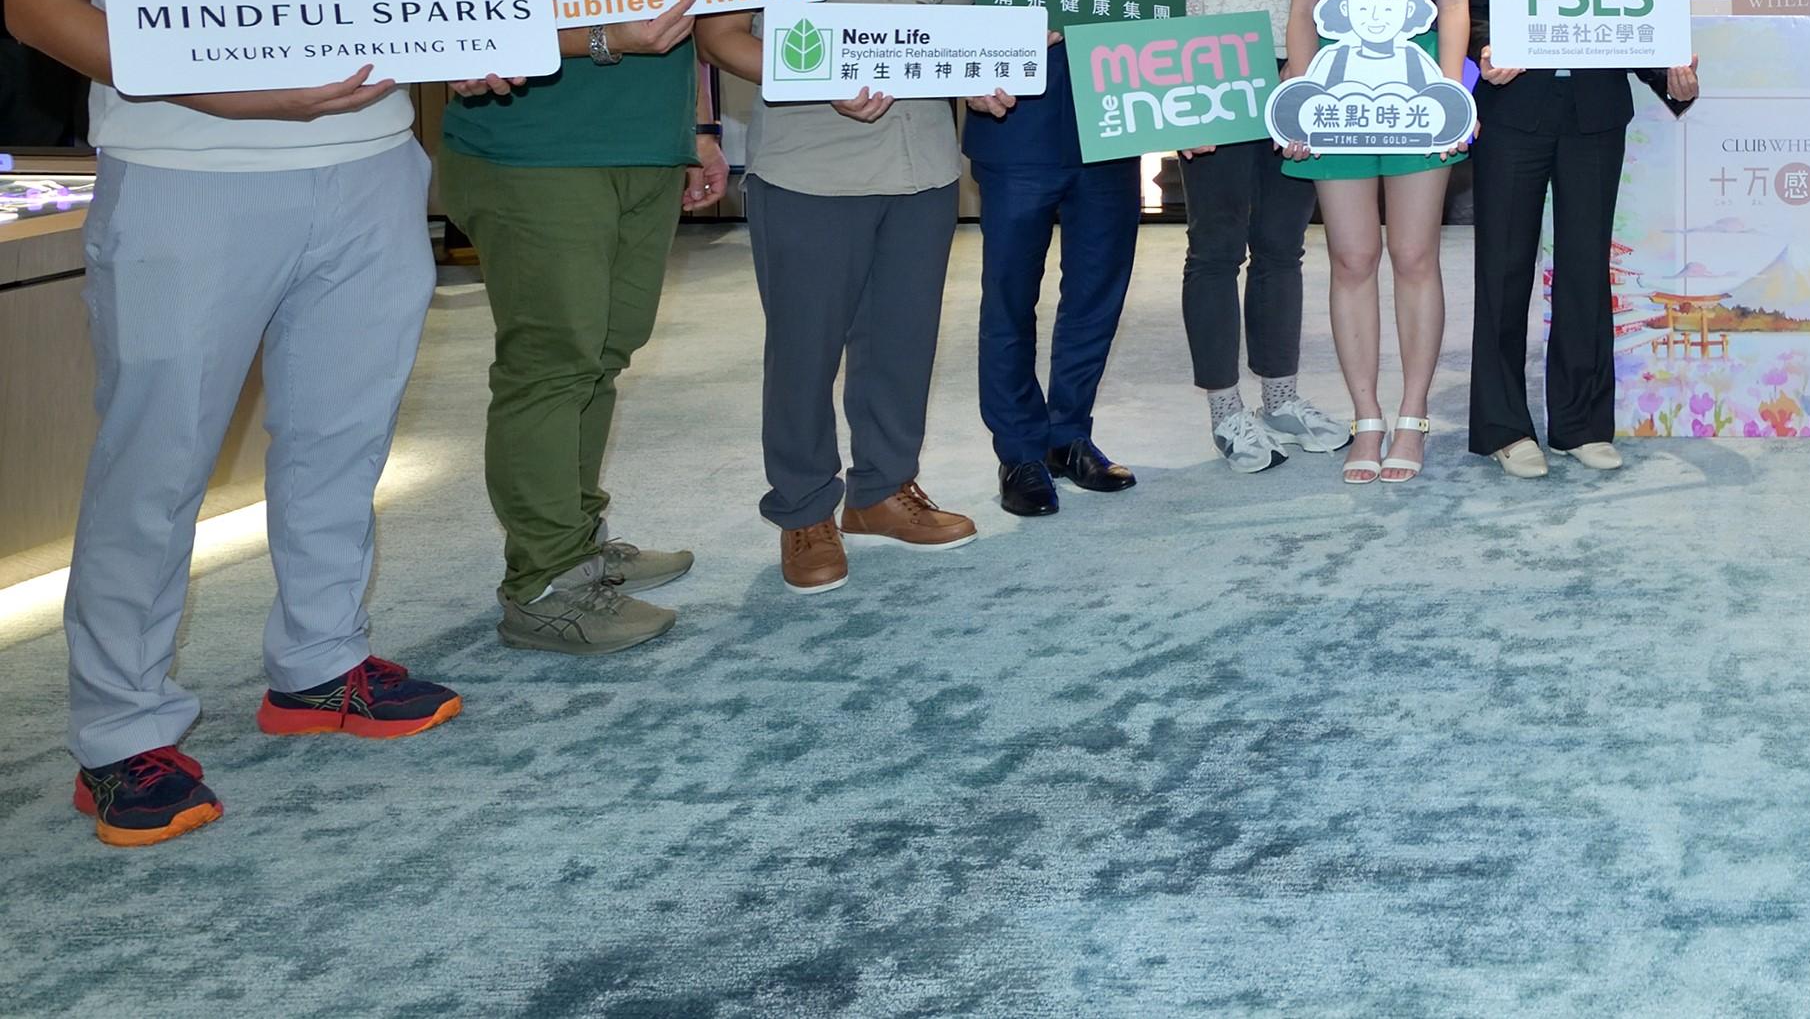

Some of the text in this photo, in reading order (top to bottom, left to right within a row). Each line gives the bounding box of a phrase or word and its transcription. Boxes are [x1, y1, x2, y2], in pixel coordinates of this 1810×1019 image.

[136, 0, 532, 30] MINDFUL SPARKS
[842, 28, 931, 45] New Life
[1528, 23, 1655, 43] 豐盛社企學會
[191, 38, 497, 62] LUXURY SPARKLING TEA
[841, 48, 1037, 61] Psychiatric Rehabilitation Association
[1527, 47, 1656, 57] Fullness Social Enterprises Society
[841, 61, 1038, 81] 新生精神康復會
[1098, 94, 1123, 138] the
[1313, 103, 1430, 129] 糕點時光
[1333, 135, 1408, 145] TIME TO GOLD
